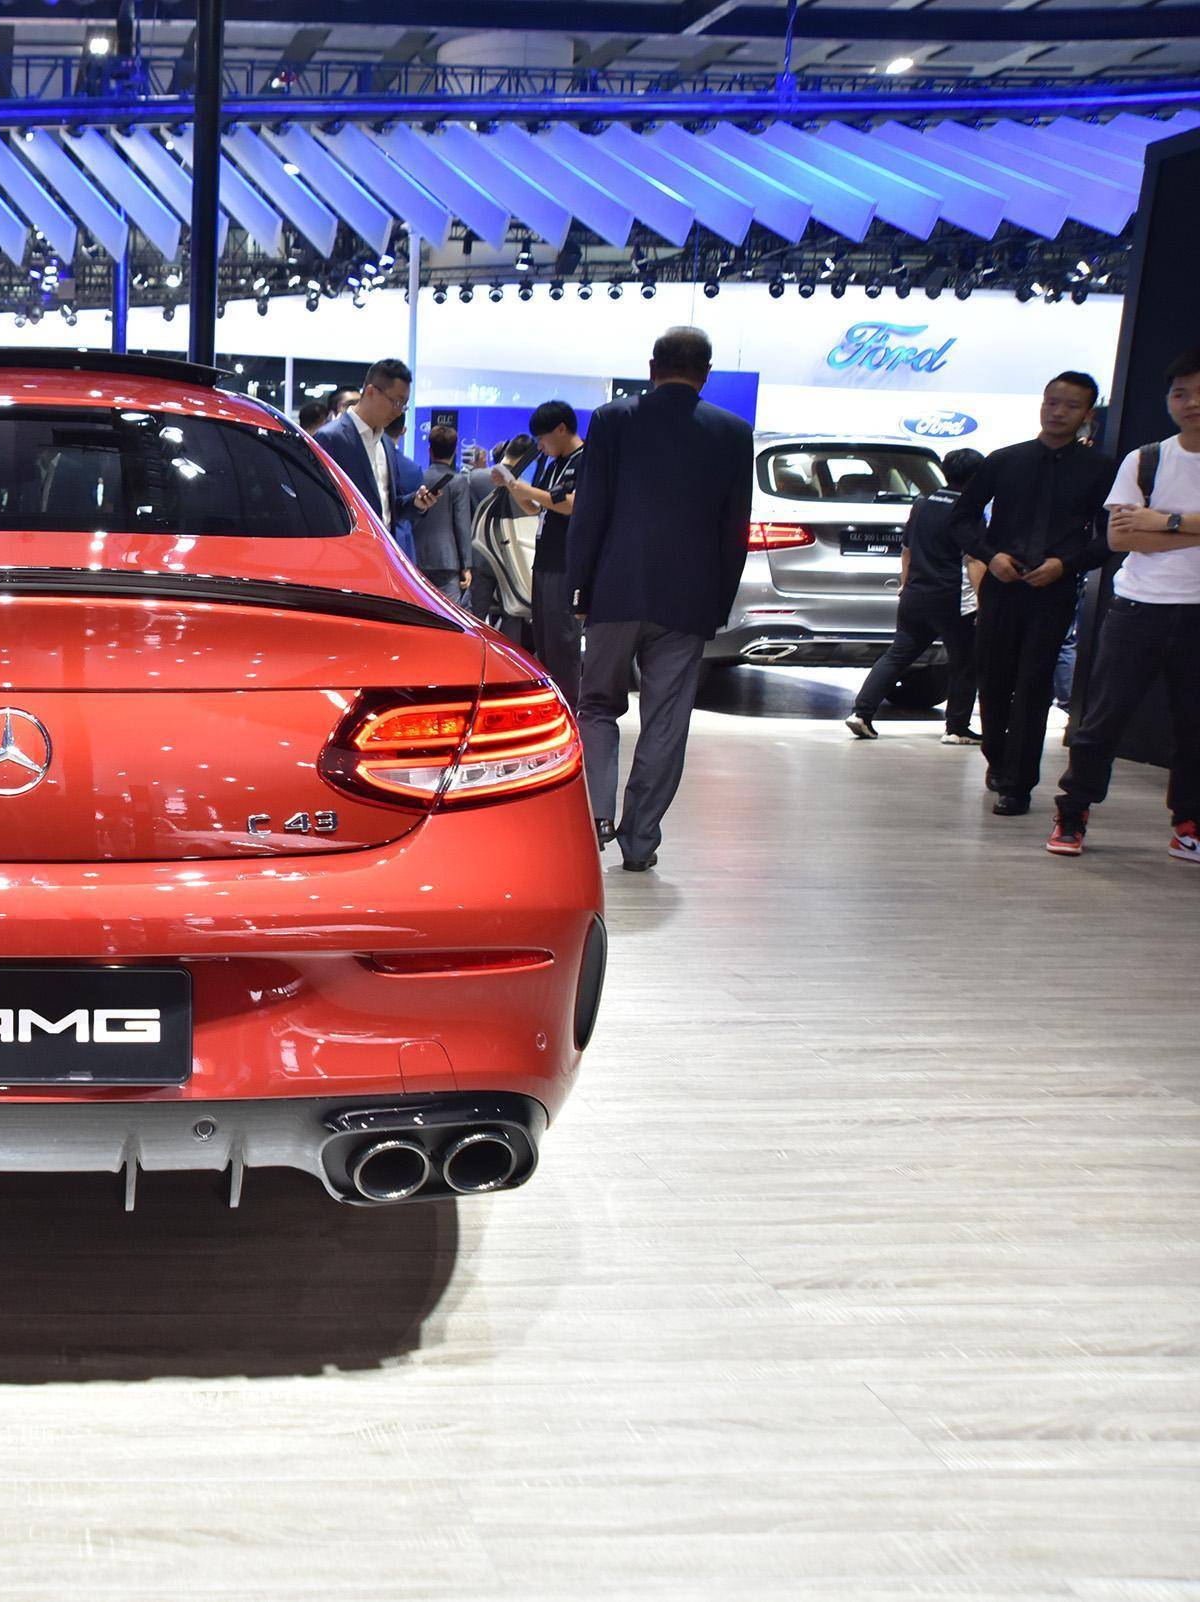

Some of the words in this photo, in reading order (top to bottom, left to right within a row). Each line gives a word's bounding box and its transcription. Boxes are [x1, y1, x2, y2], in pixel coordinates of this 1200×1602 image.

[826, 321, 958, 373] Ford
[867, 544, 889, 554] Luxury
[248, 813, 272, 837] C
[284, 810, 339, 833] 43
